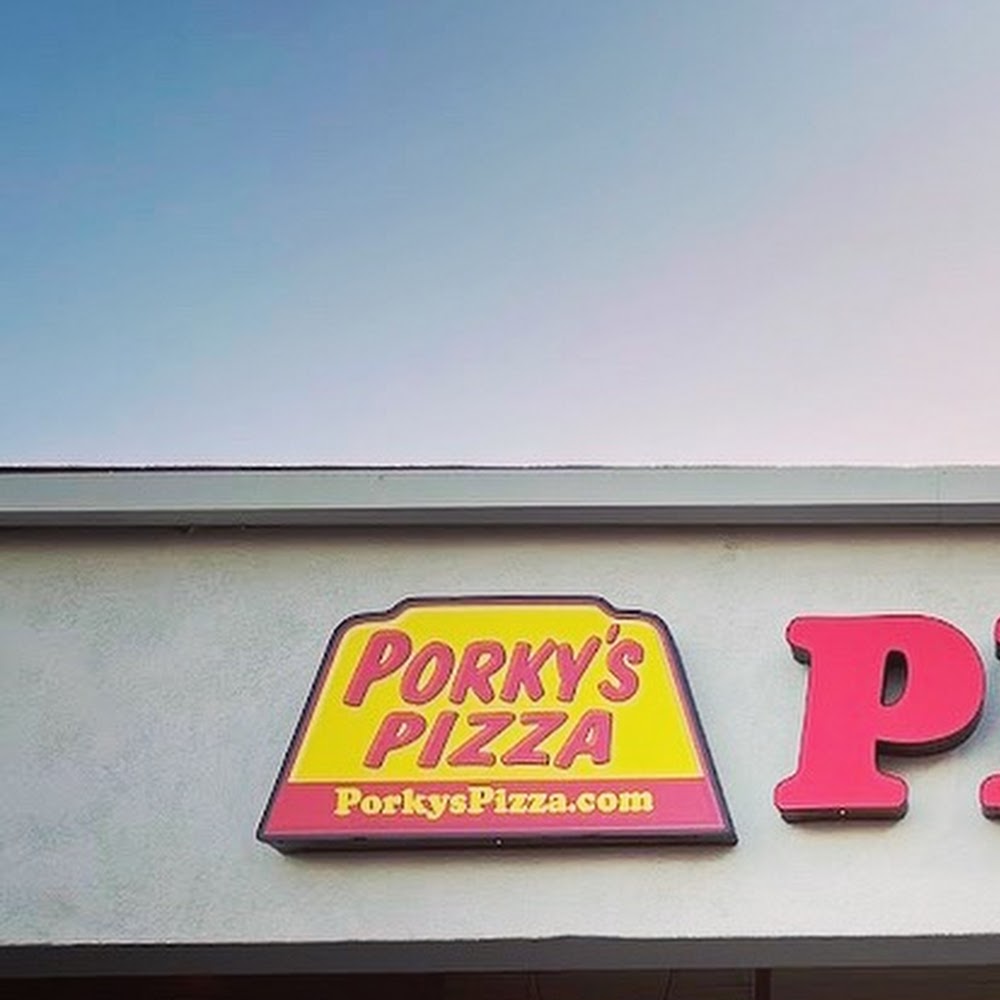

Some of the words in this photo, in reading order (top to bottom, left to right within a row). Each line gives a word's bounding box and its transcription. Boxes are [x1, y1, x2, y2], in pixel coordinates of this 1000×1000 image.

[343, 624, 644, 707] PORKY'S
[364, 709, 614, 769] PIZZA
[333, 785, 654, 818] PorkysPizza.com
